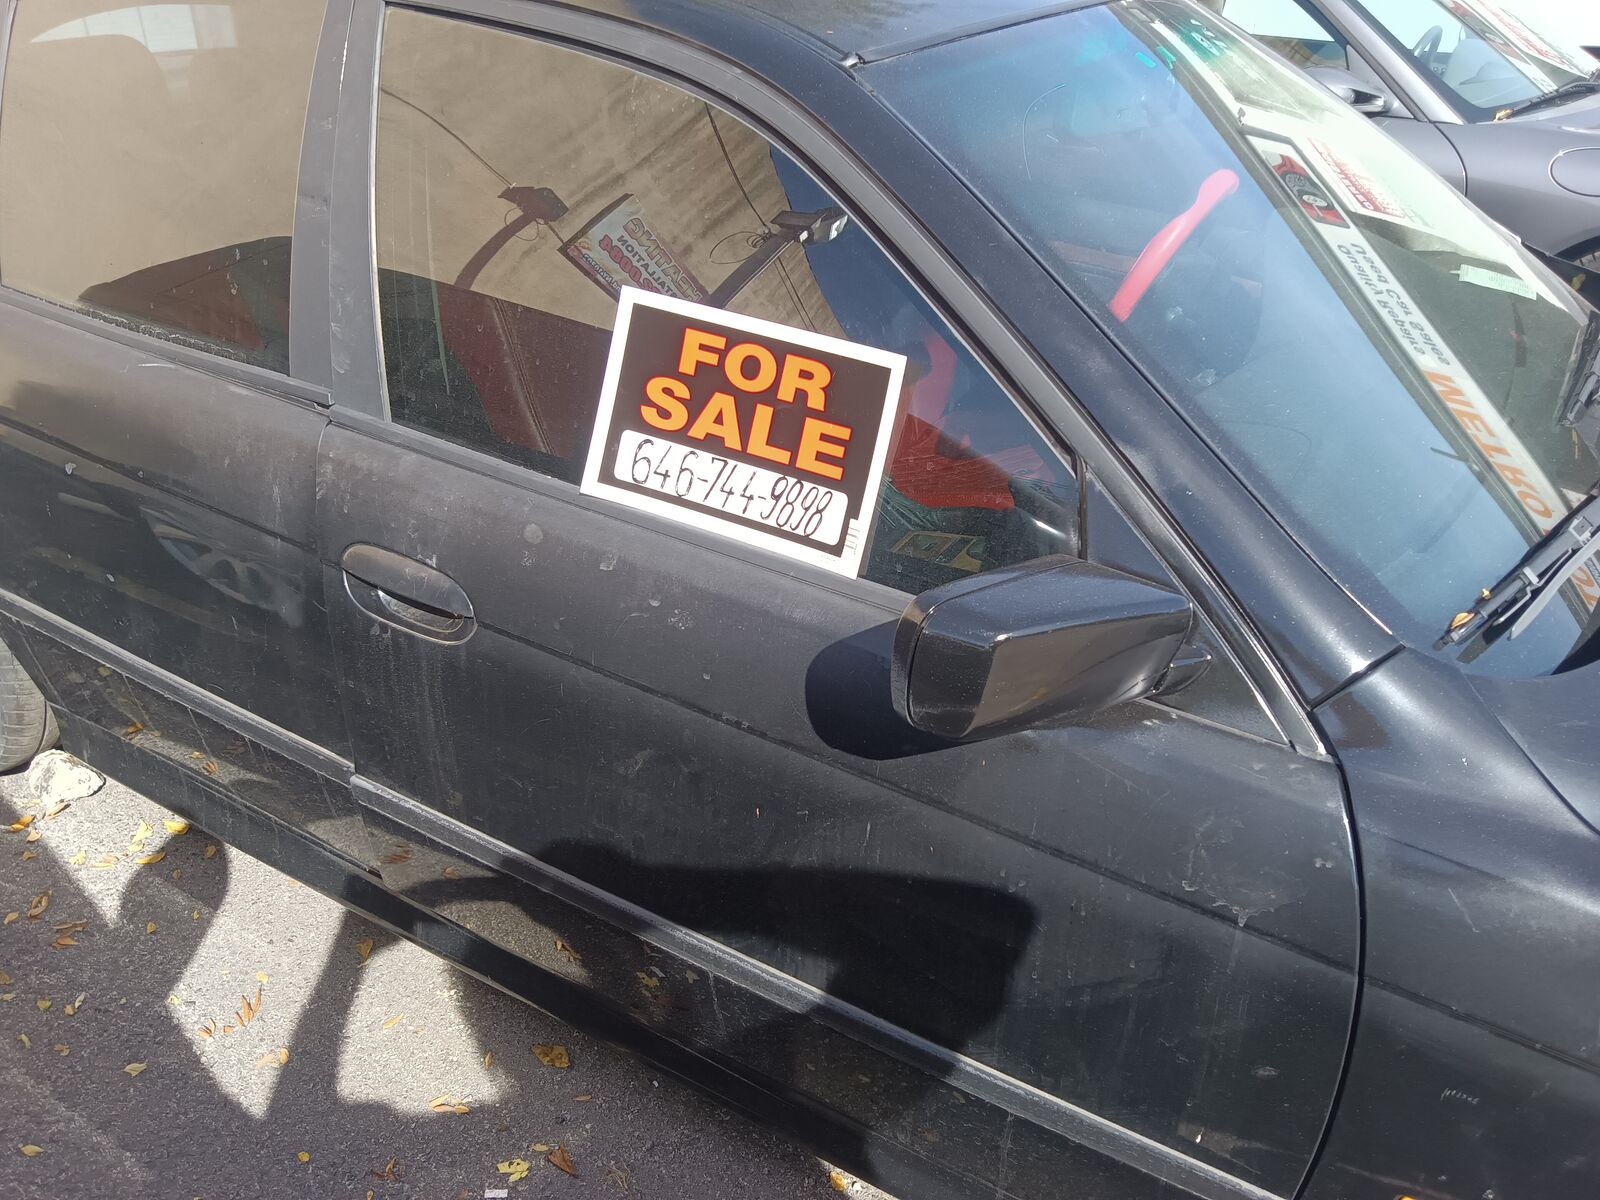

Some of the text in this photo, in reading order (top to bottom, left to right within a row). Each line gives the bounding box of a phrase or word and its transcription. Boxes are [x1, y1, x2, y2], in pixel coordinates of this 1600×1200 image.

[678, 327, 832, 412] FOR
[640, 376, 852, 481] SALE
[632, 438, 833, 537] 646-744-9898
